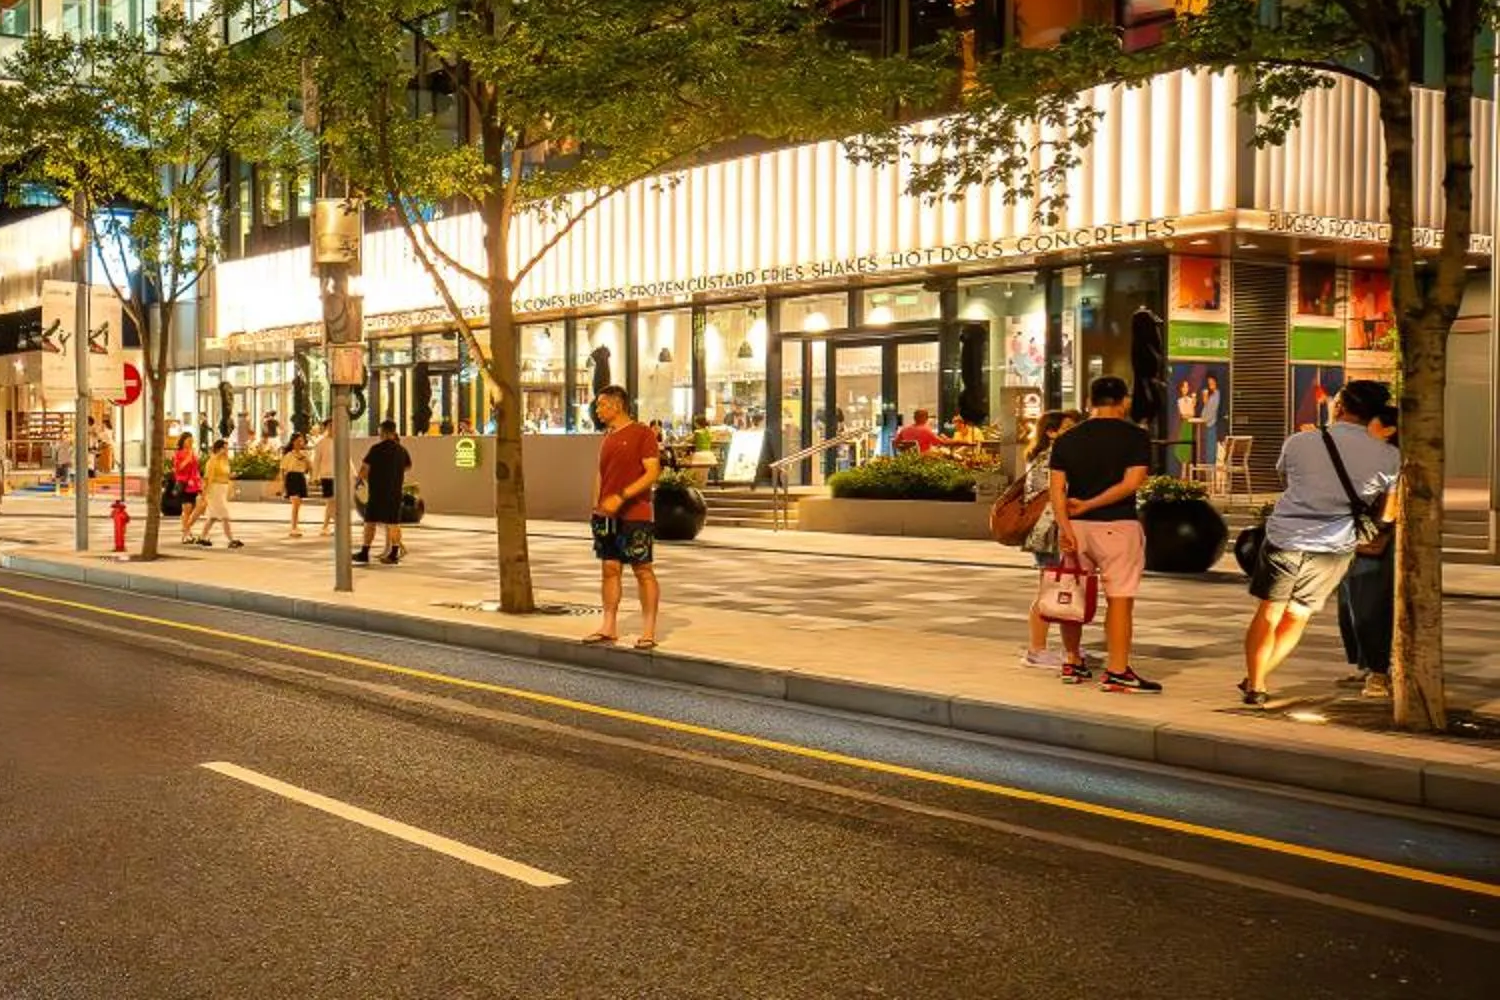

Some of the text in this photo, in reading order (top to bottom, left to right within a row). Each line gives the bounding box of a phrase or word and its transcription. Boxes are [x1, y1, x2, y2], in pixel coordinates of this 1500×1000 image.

[1269, 212, 1325, 235] BURGERS
[1329, 219, 1375, 240] FROZEN
[524, 295, 565, 312] CONES
[570, 287, 625, 307] BURGERS
[630, 280, 685, 298] FROZEN
[687, 271, 756, 292] CUSTARD
[761, 265, 803, 284] FRIES
[811, 256, 879, 278] SHAKES
[891, 249, 934, 268] HOT
[941, 242, 1003, 263] DOGS
[1017, 219, 1176, 254] CONCRETES
